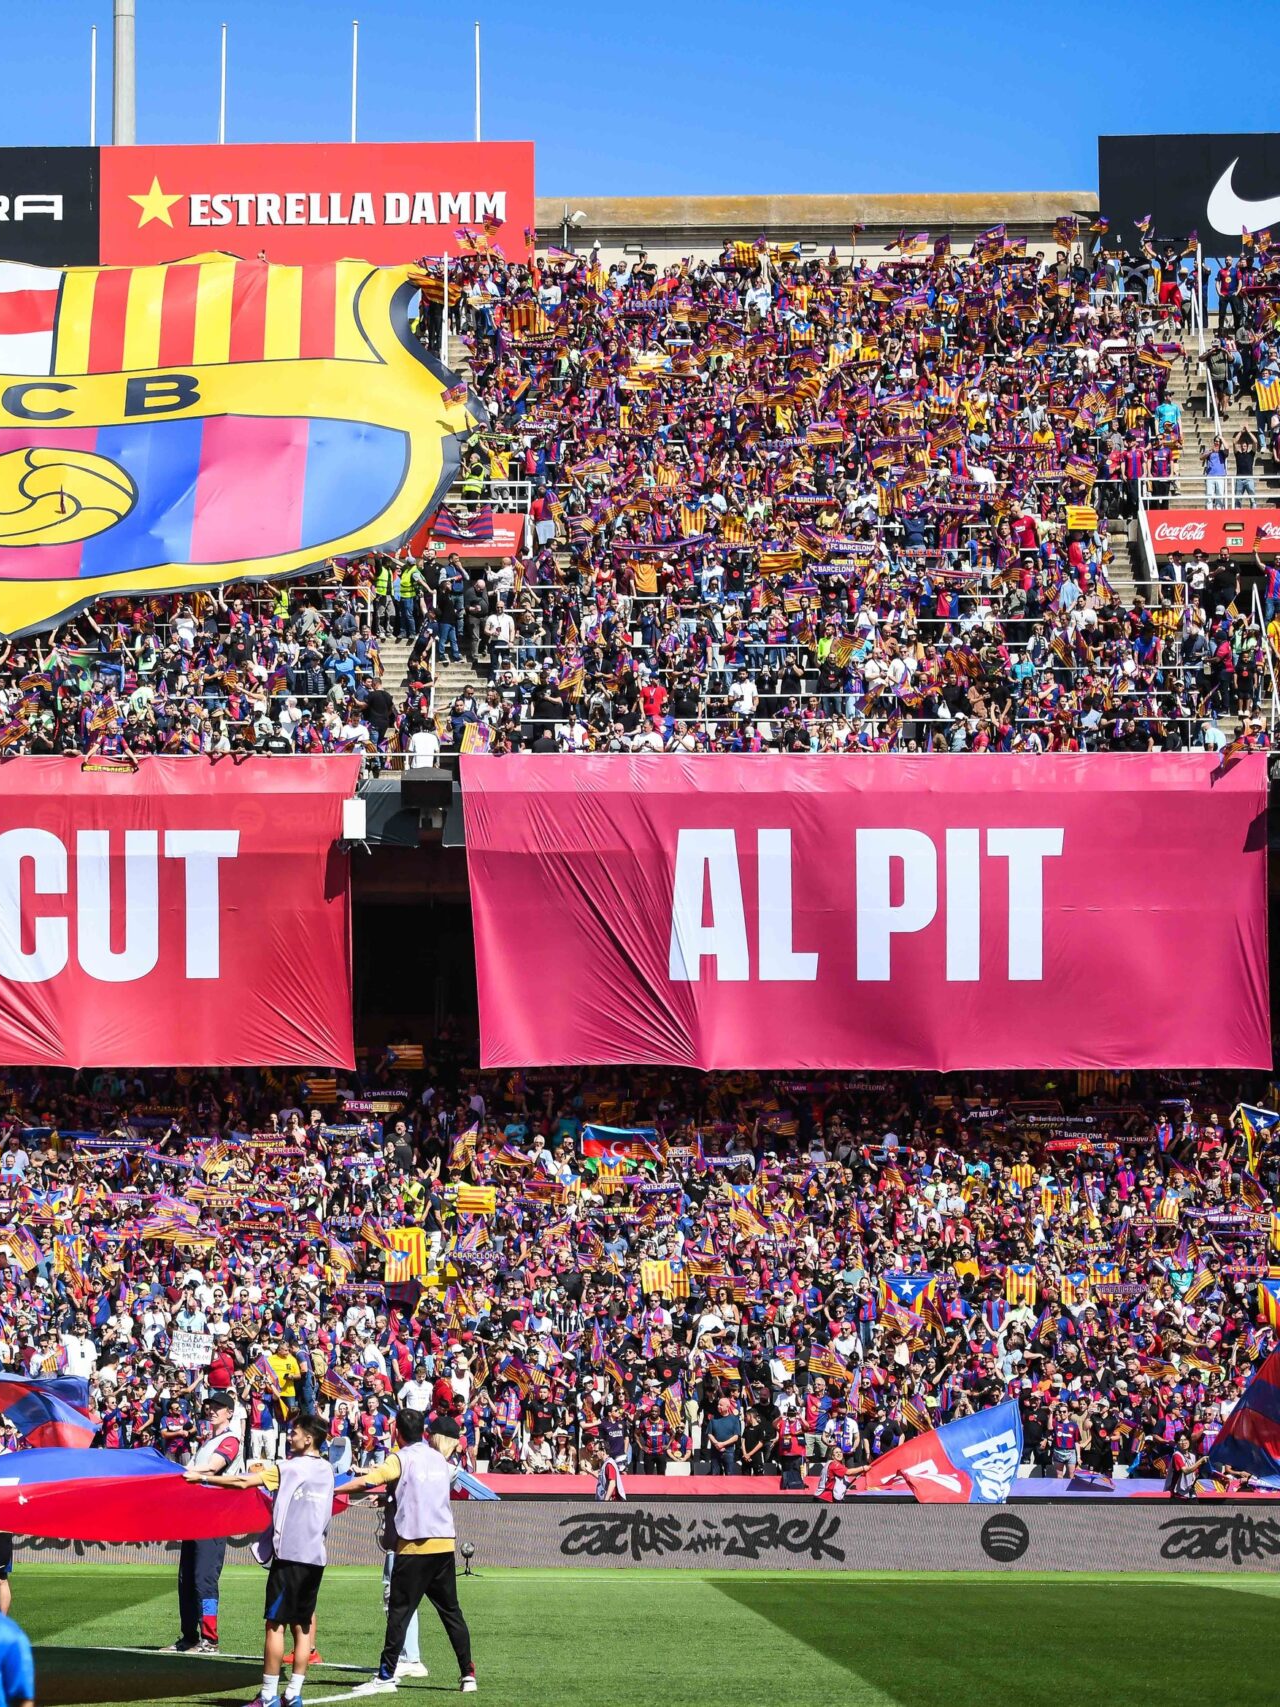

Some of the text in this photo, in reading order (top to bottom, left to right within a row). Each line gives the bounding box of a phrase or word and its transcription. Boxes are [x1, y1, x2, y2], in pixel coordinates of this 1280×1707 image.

[188, 191, 507, 226] ESTRELLA DAMM
[1155, 522, 1207, 540] Coca-Cola
[839, 543, 875, 552] BARCELONA
[819, 565, 855, 573] BARCELONA
[137, 697, 143, 709] 8
[668, 827, 1064, 981] AL PIT
[372, 1090, 408, 1099] BARCELONA
[1064, 1132, 1102, 1140] BARCELONA
[351, 1156, 373, 1164] BARÇA
